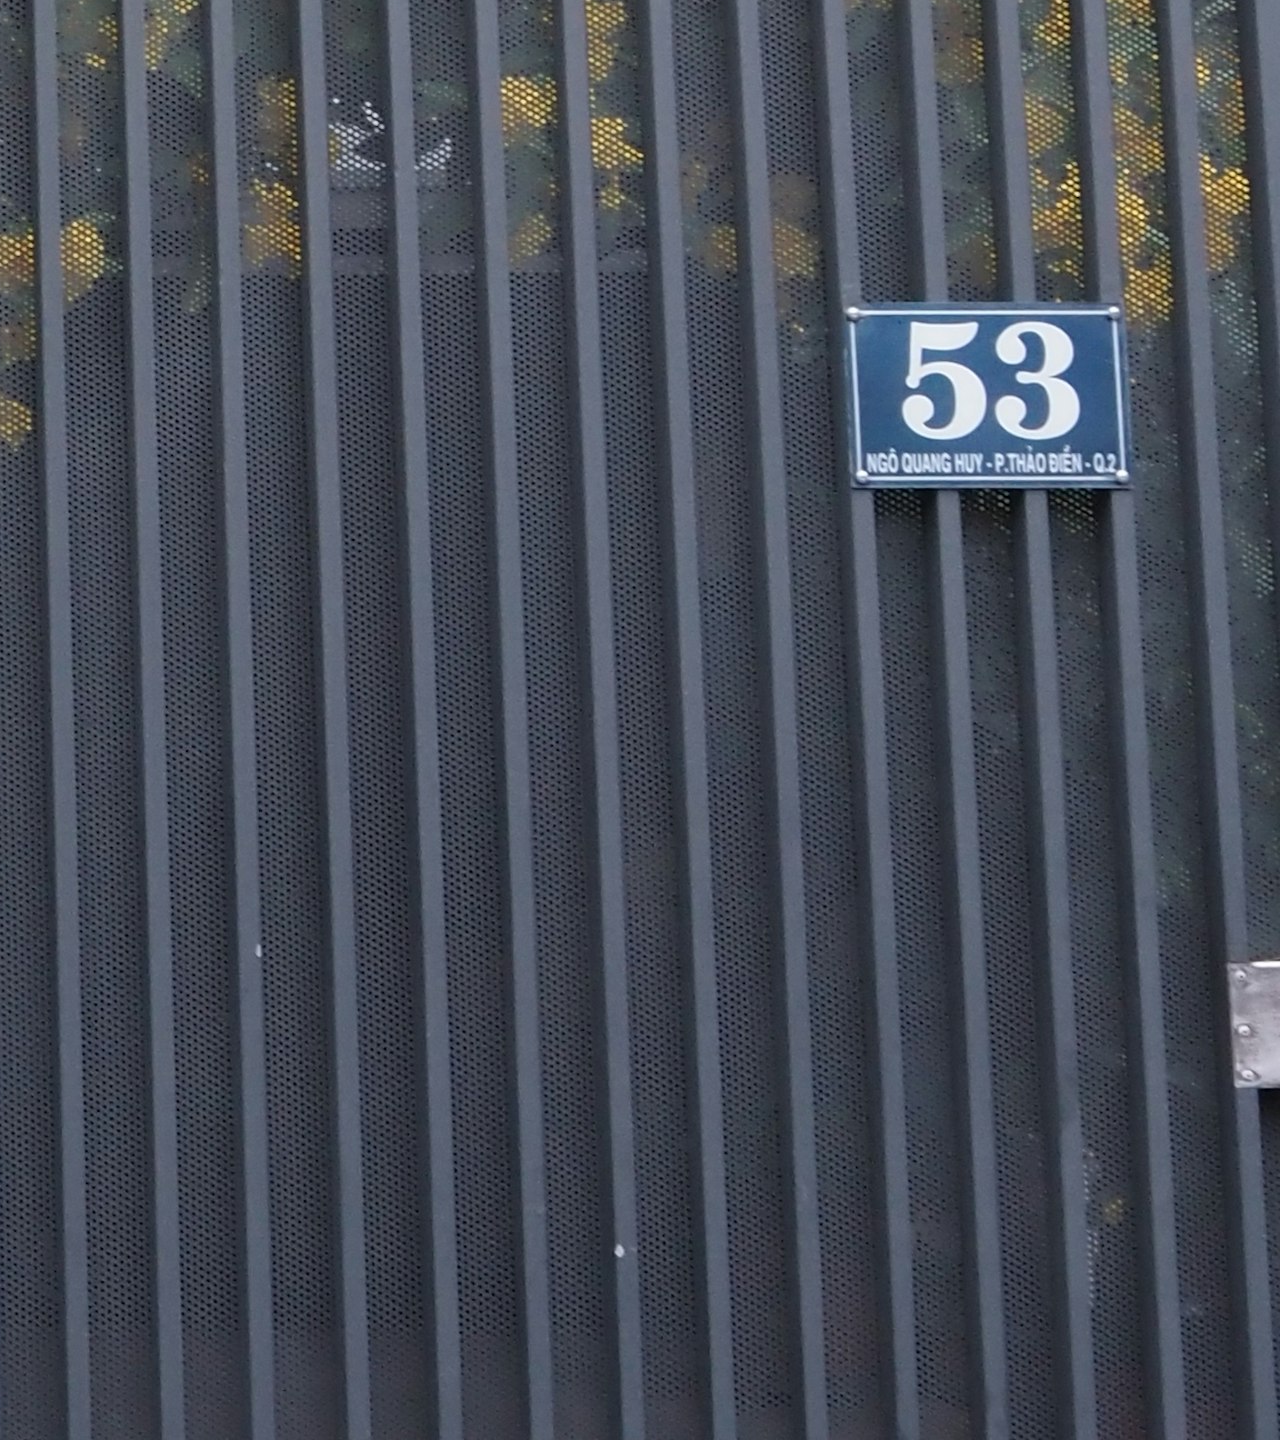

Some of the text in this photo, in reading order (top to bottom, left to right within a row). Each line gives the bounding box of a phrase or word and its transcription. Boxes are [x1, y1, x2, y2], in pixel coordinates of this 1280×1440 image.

[902, 321, 1081, 441] 53
[866, 447, 899, 473] NGÔ
[901, 452, 952, 474] QUANG
[954, 452, 984, 474] HUY
[1093, 452, 1117, 474] Q.2
